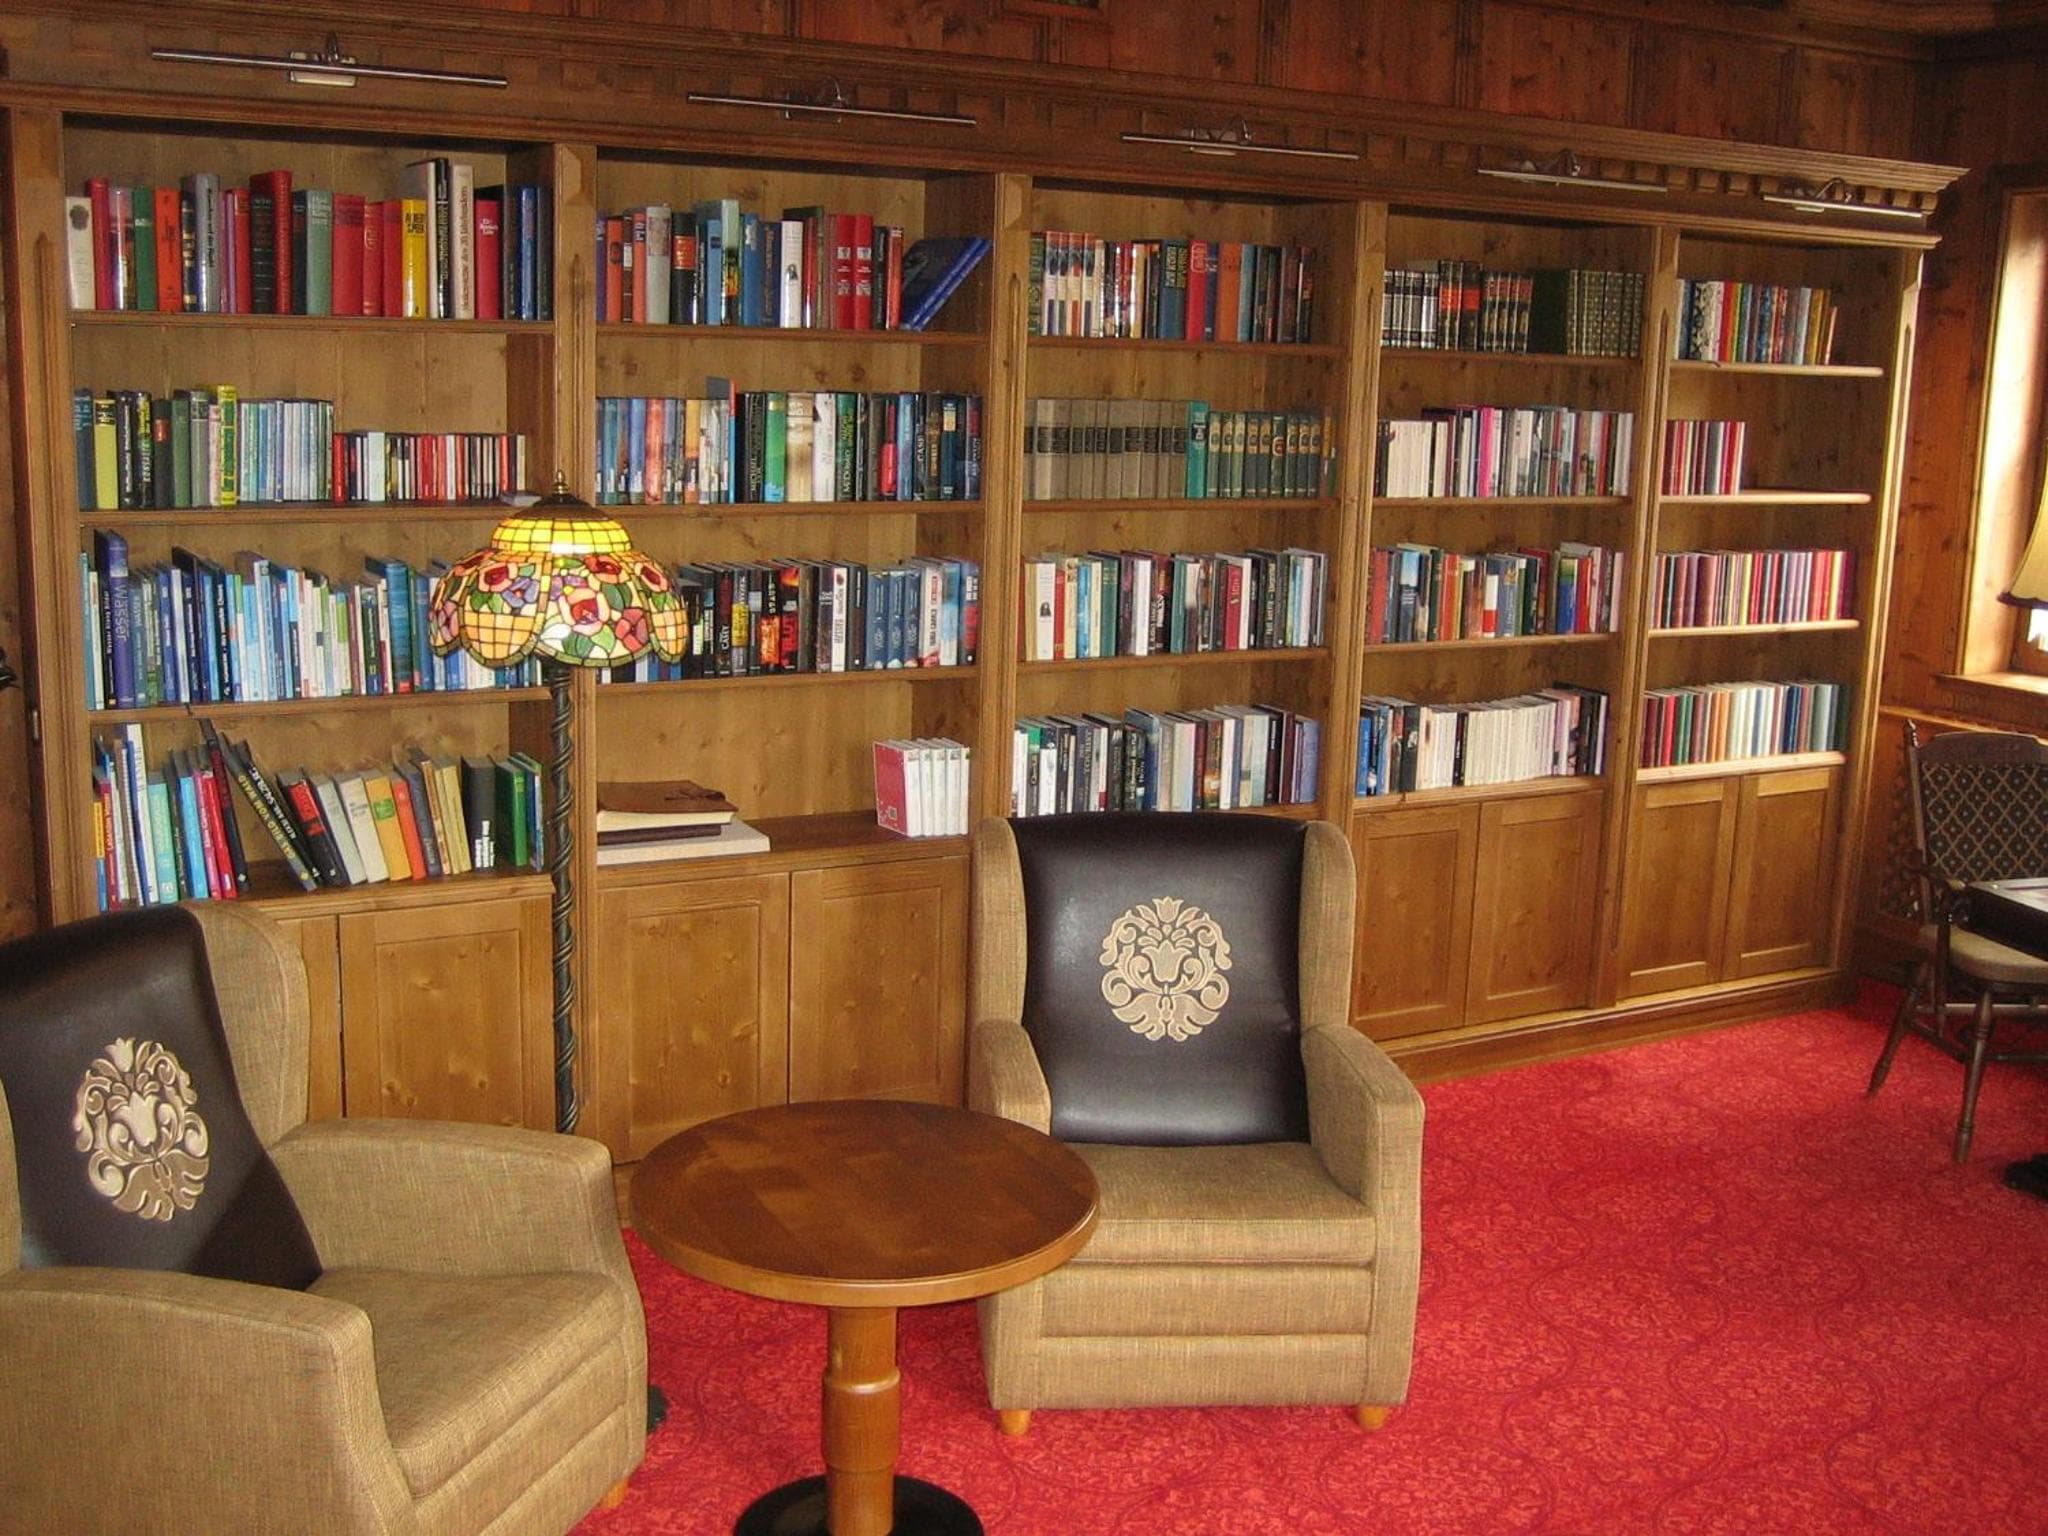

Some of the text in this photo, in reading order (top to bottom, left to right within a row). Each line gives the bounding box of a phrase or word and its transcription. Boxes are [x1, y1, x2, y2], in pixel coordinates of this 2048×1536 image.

[113, 584, 128, 642] Wasser
[236, 773, 297, 860] DAS BILD VOM WALD
